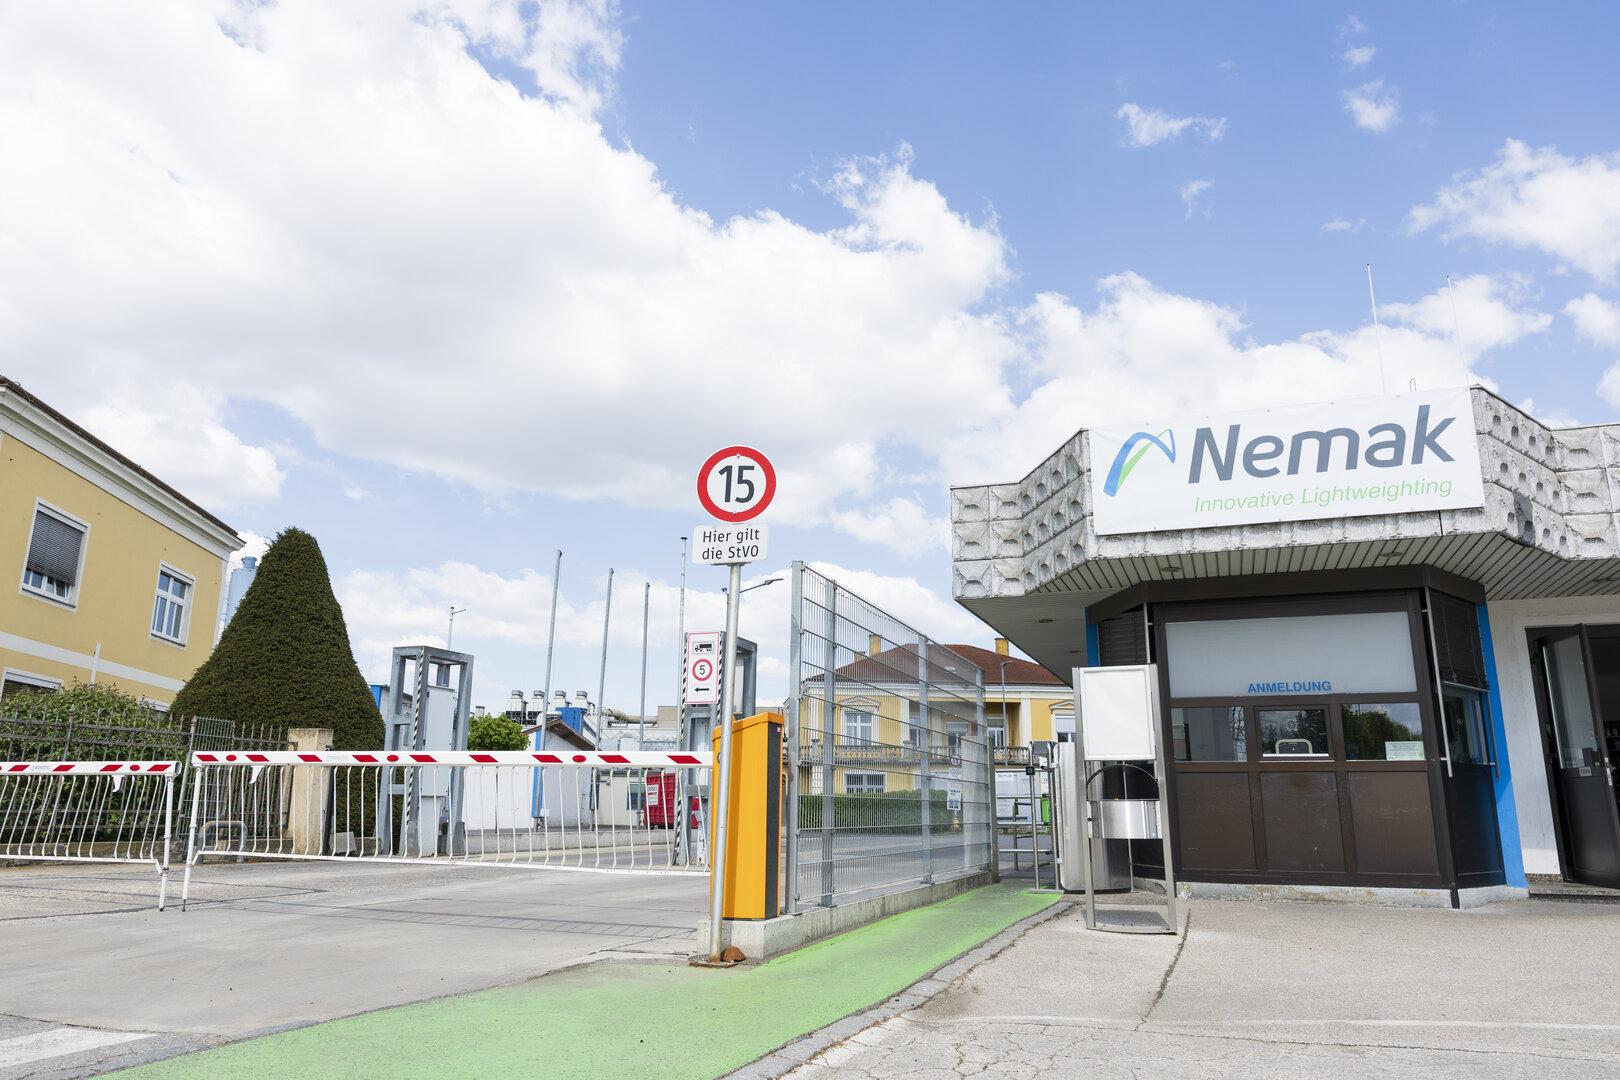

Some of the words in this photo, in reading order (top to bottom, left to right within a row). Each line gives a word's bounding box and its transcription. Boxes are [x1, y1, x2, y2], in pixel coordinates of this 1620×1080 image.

[1188, 404, 1456, 484] Nemak
[718, 465, 755, 503] 15
[1194, 491, 1294, 513] Innovative
[1301, 478, 1453, 507] Lightweighting
[703, 530, 731, 543] Hier
[736, 528, 760, 544] gilt
[702, 547, 723, 560] die
[728, 545, 759, 559] StVO
[699, 664, 706, 675] 5
[1247, 681, 1332, 693] ANMELDUNG
